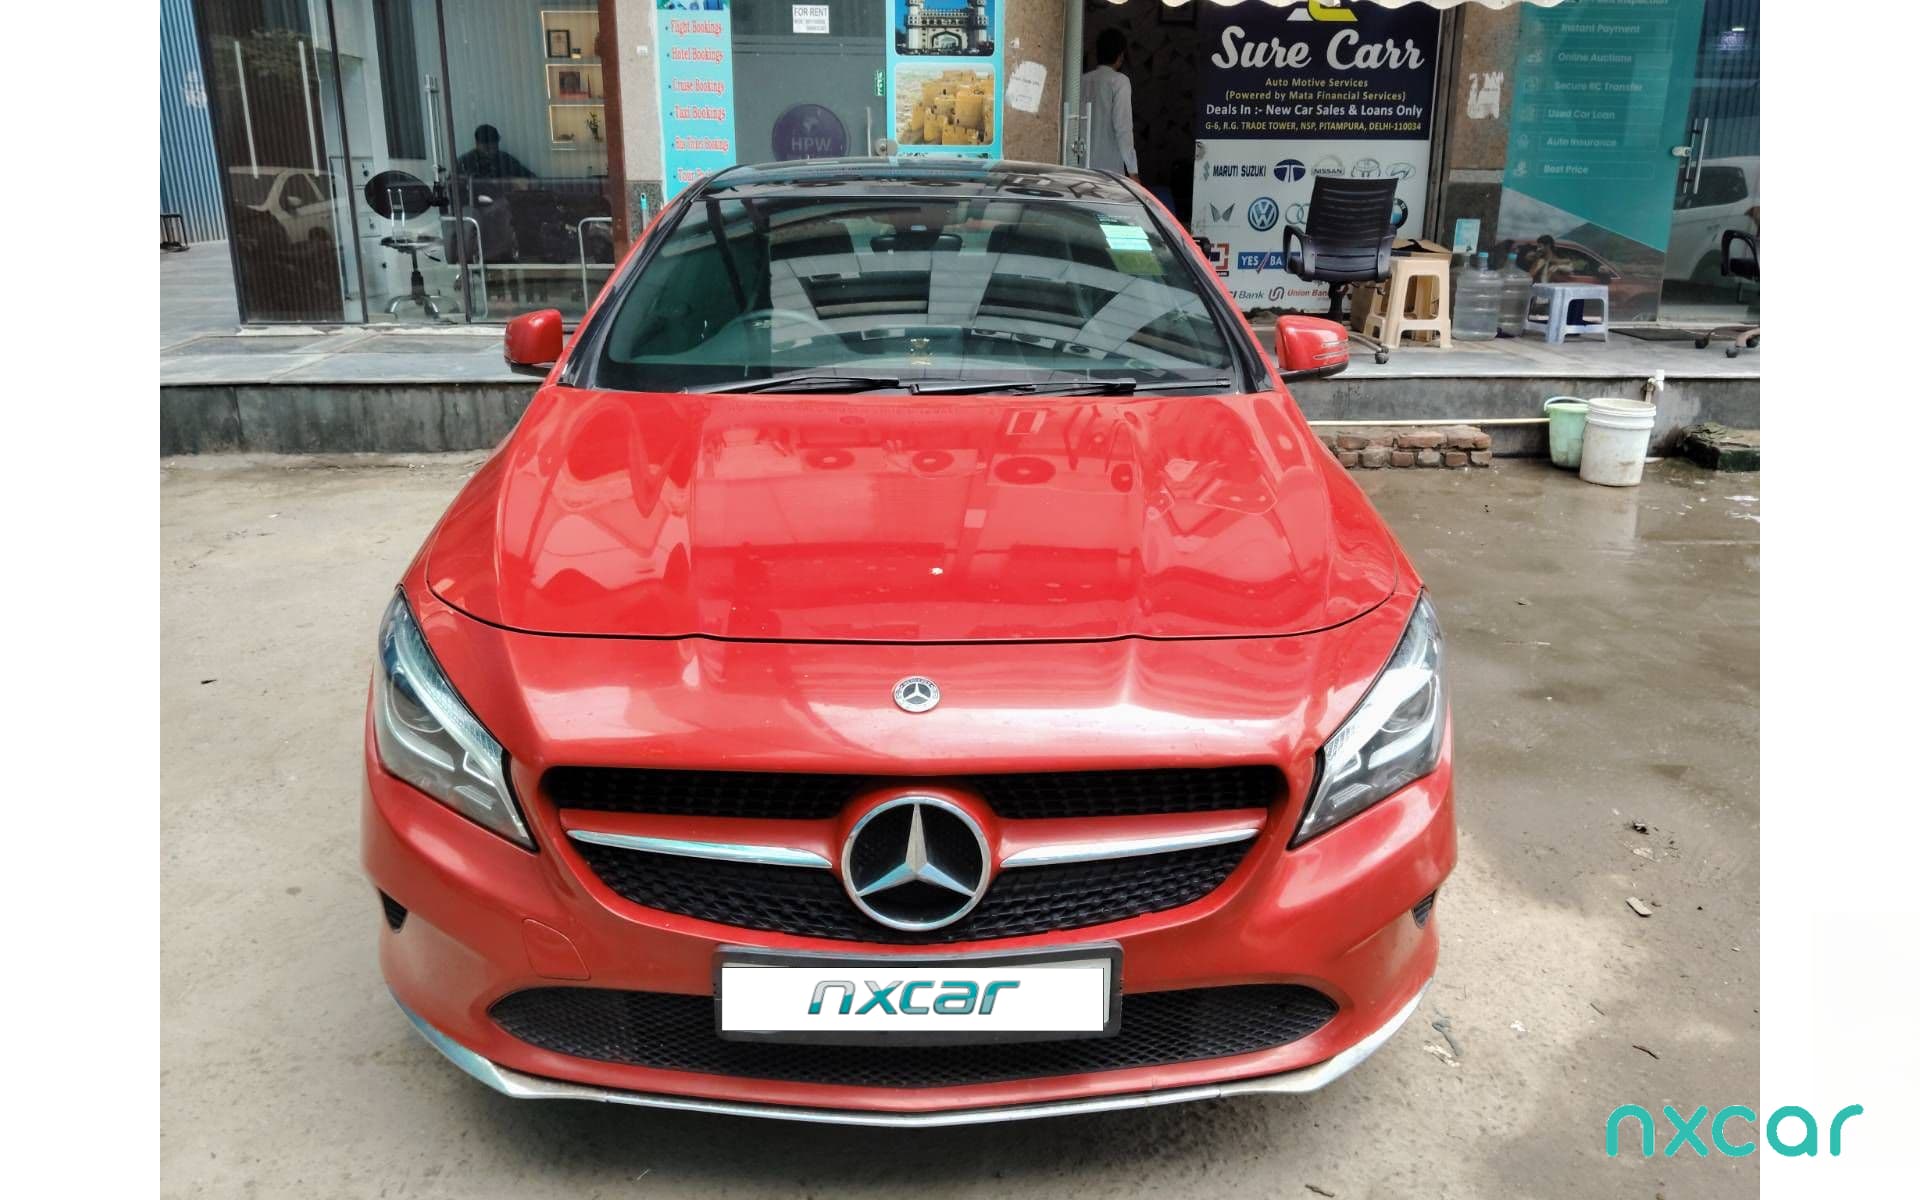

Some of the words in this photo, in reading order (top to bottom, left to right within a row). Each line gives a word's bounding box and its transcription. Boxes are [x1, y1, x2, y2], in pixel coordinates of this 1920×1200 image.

[794, 7, 809, 16] FOR
[810, 7, 828, 16] RENT
[1561, 23, 1595, 33] Instant
[1597, 23, 1640, 37] Payment
[1211, 26, 1312, 69] Sure
[1326, 29, 1425, 70] Carr
[672, 47, 691, 60] Hotel
[692, 47, 724, 63] Bookings
[1265, 78, 1289, 87] Auto
[1292, 77, 1326, 87] Motive
[1328, 78, 1368, 88] Services
[1226, 90, 1271, 101] (Powered
[1274, 91, 1286, 101] by
[1289, 91, 1313, 100] Mata
[1317, 91, 1360, 100] Financial
[1363, 91, 1406, 102] Services)
[1206, 104, 1237, 115] Deals
[1240, 104, 1251, 115] In
[1266, 104, 1291, 115] New
[1294, 104, 1313, 115] Car
[1316, 104, 1345, 115] Sales
[1348, 104, 1357, 115] &
[1361, 104, 1393, 116] Loans
[1396, 104, 1423, 118] Only
[1223, 121, 1239, 130] R.G.
[1241, 121, 1267, 130] TRADE
[1269, 121, 1298, 132] TOWER,
[1300, 122, 1317, 132] NSP,
[1319, 122, 1367, 132] PITAMPURA,
[1369, 122, 1421, 131] DELHI-110034
[791, 136, 832, 153] HPW
[678, 168, 694, 181] Tour
[1212, 165, 1238, 177] MARUTI
[1241, 165, 1267, 177] SUZUKI
[1565, 164, 1589, 175] Price
[1241, 256, 1259, 266] YES
[1239, 290, 1264, 300] Bank
[1287, 288, 1310, 297] Union
[1311, 288, 1329, 297] Ban
